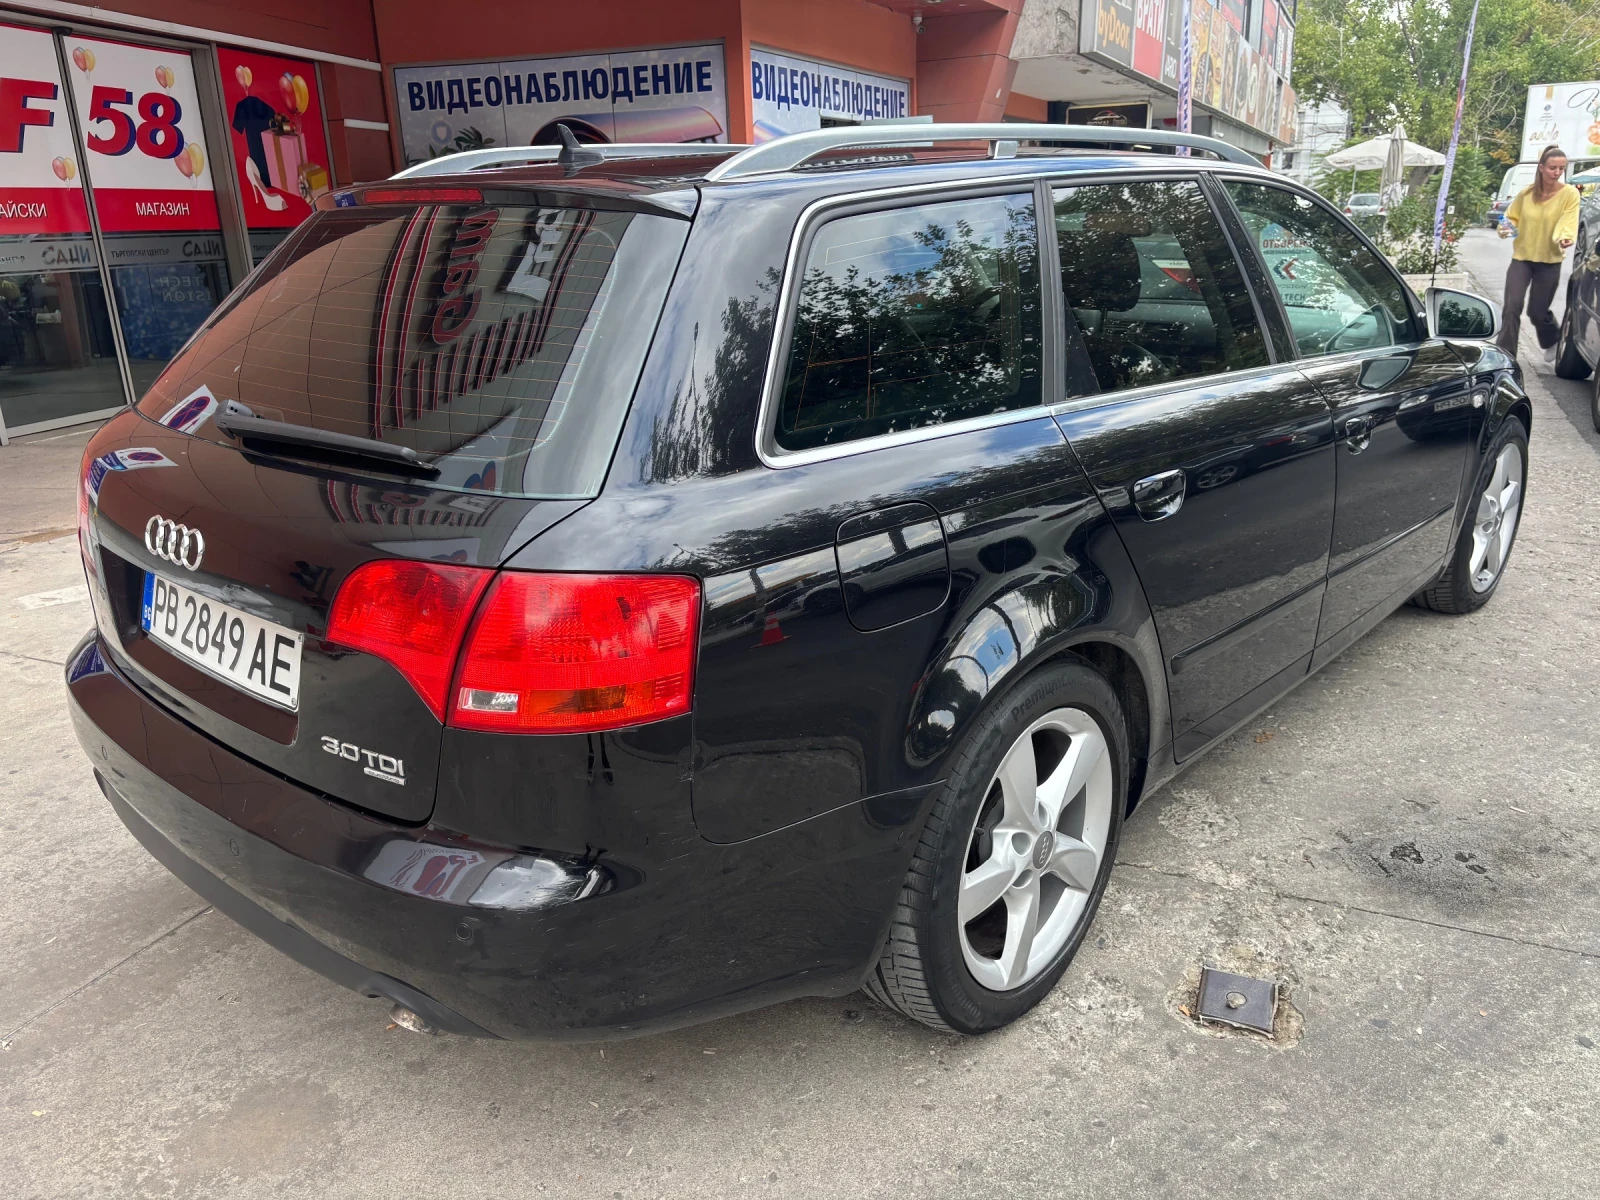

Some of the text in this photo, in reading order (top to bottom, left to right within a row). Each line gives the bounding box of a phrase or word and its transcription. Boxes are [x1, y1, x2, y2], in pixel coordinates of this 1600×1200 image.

[407, 60, 713, 115] ВИДЕОНАБЛЮДЕНИЕ
[751, 61, 905, 120] ВИДЕОНАБЛЮДЕНИЕ
[135, 202, 190, 216] МАГАЗИН
[153, 578, 296, 696] PB 2849 AE
[320, 735, 404, 777] 3.0 TDI
